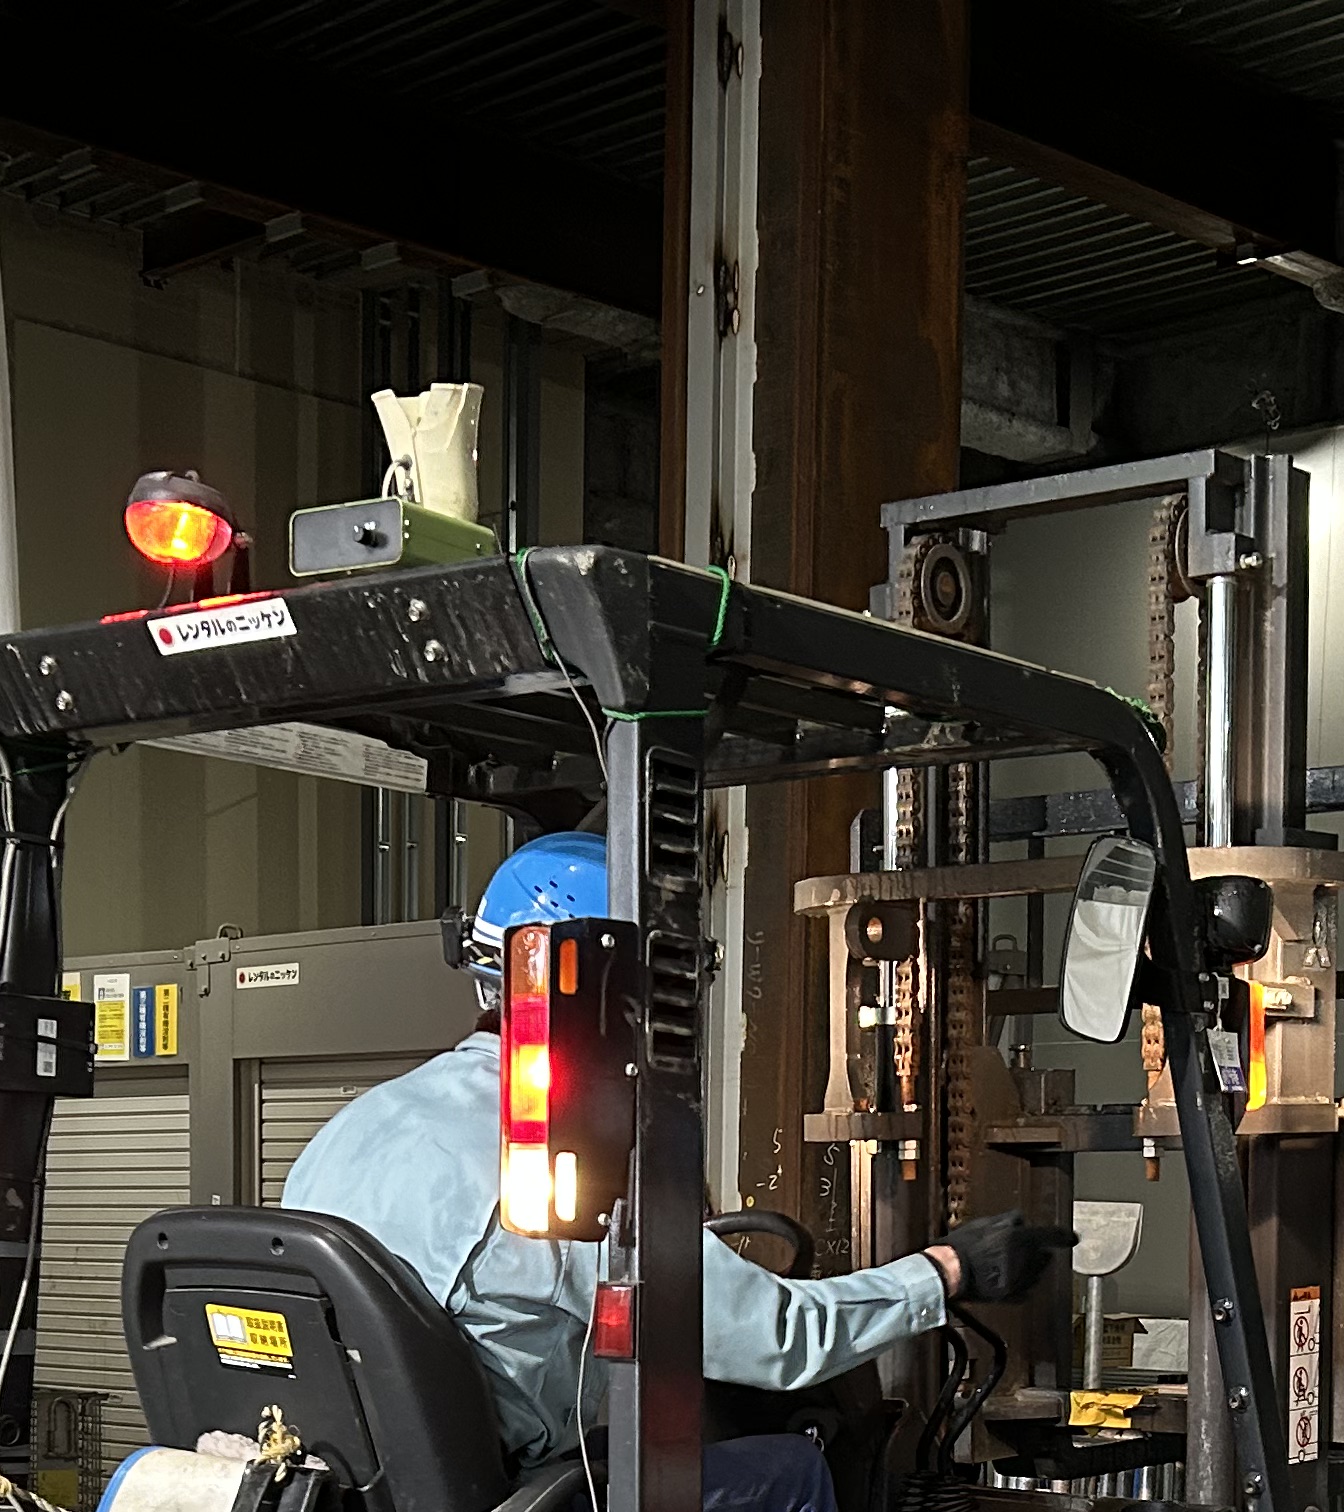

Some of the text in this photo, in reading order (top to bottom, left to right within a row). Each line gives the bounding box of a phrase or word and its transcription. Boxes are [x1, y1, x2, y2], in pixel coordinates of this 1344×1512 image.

[176, 609, 286, 642] レンタルのニッケン
[248, 968, 297, 983] レンタルのニッケン
[245, 1316, 285, 1333] 取扱説明書
